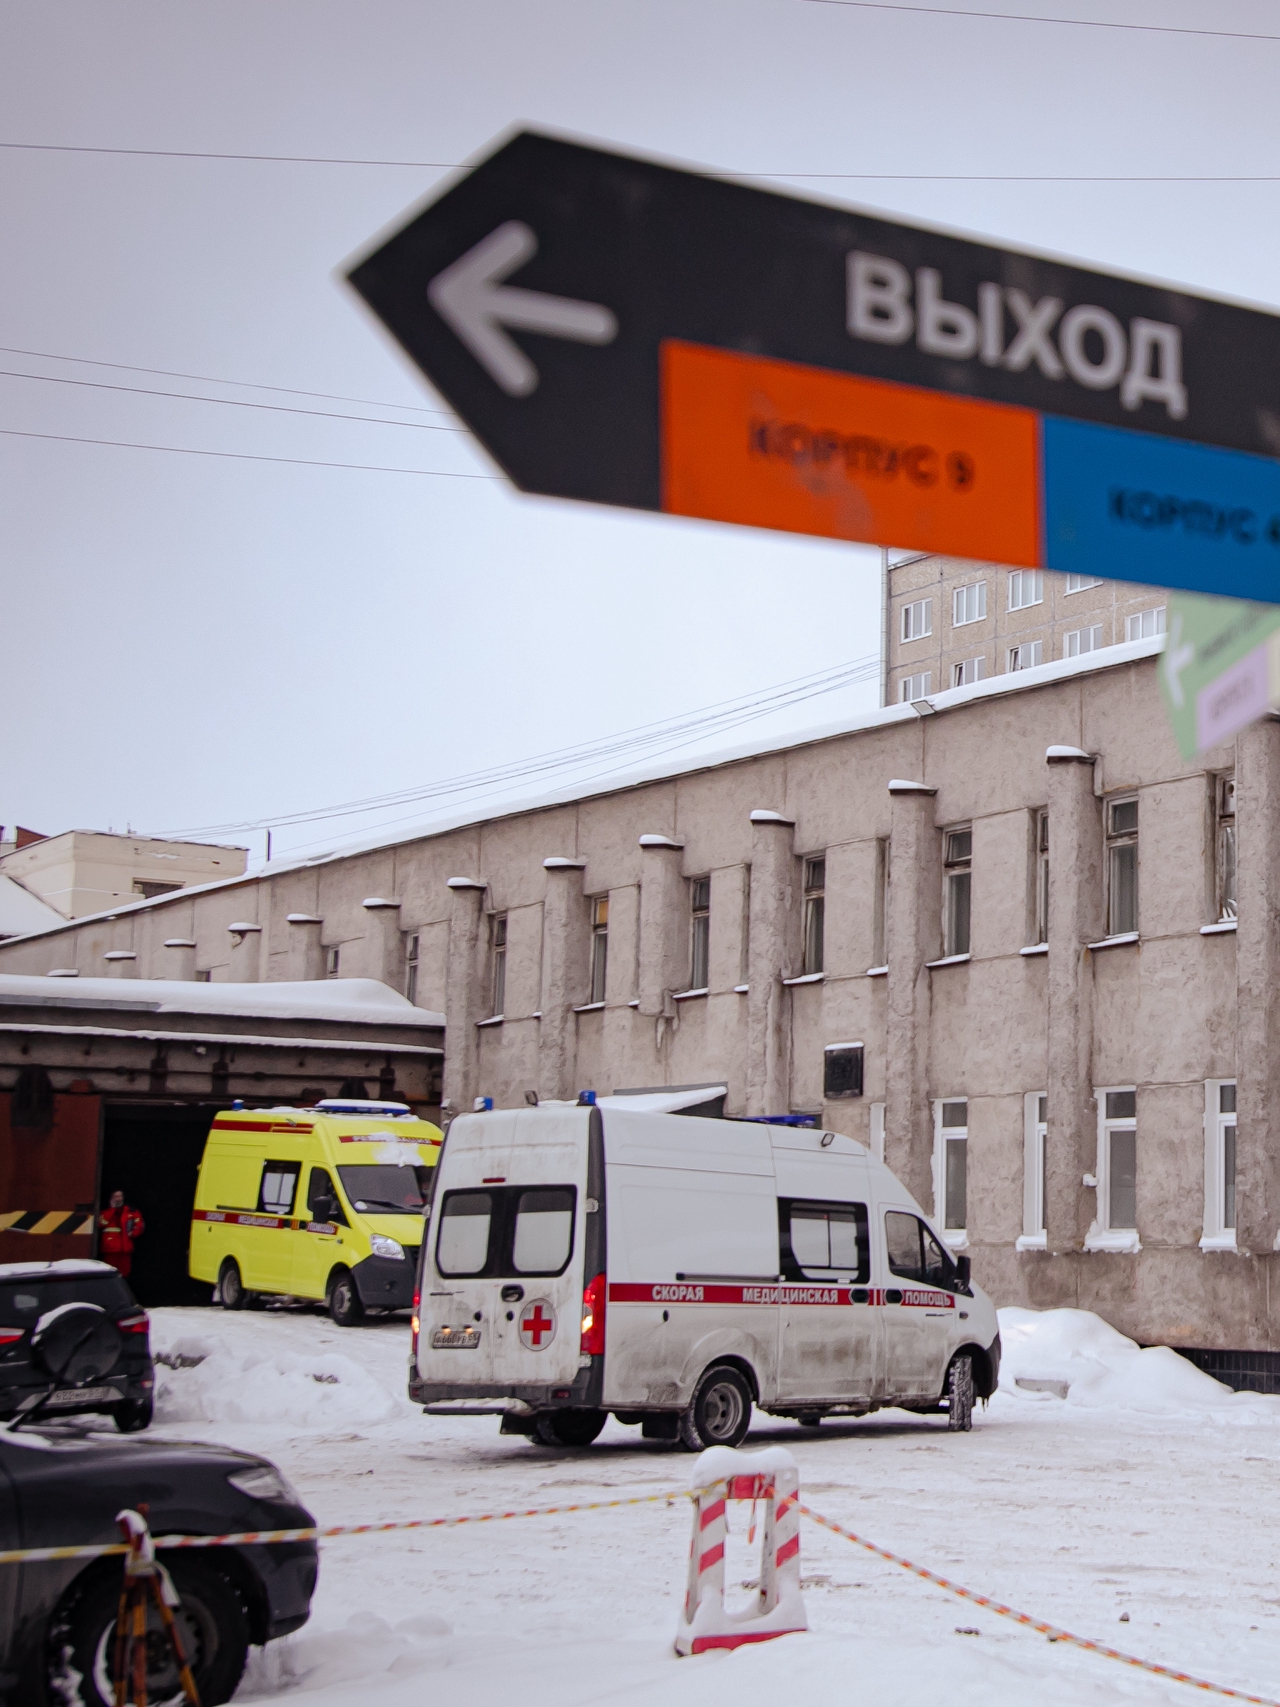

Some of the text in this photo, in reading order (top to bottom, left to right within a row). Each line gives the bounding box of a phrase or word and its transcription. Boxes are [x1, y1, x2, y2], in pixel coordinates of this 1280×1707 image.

[844, 249, 1188, 420] ВЫХОД
[747, 415, 939, 488] КОРПУС
[1107, 486, 1258, 546] КОРПУС
[652, 1284, 951, 1307] СКОРАЯ МЕДИЦИНСКАЯ ПОМОЩЬ
